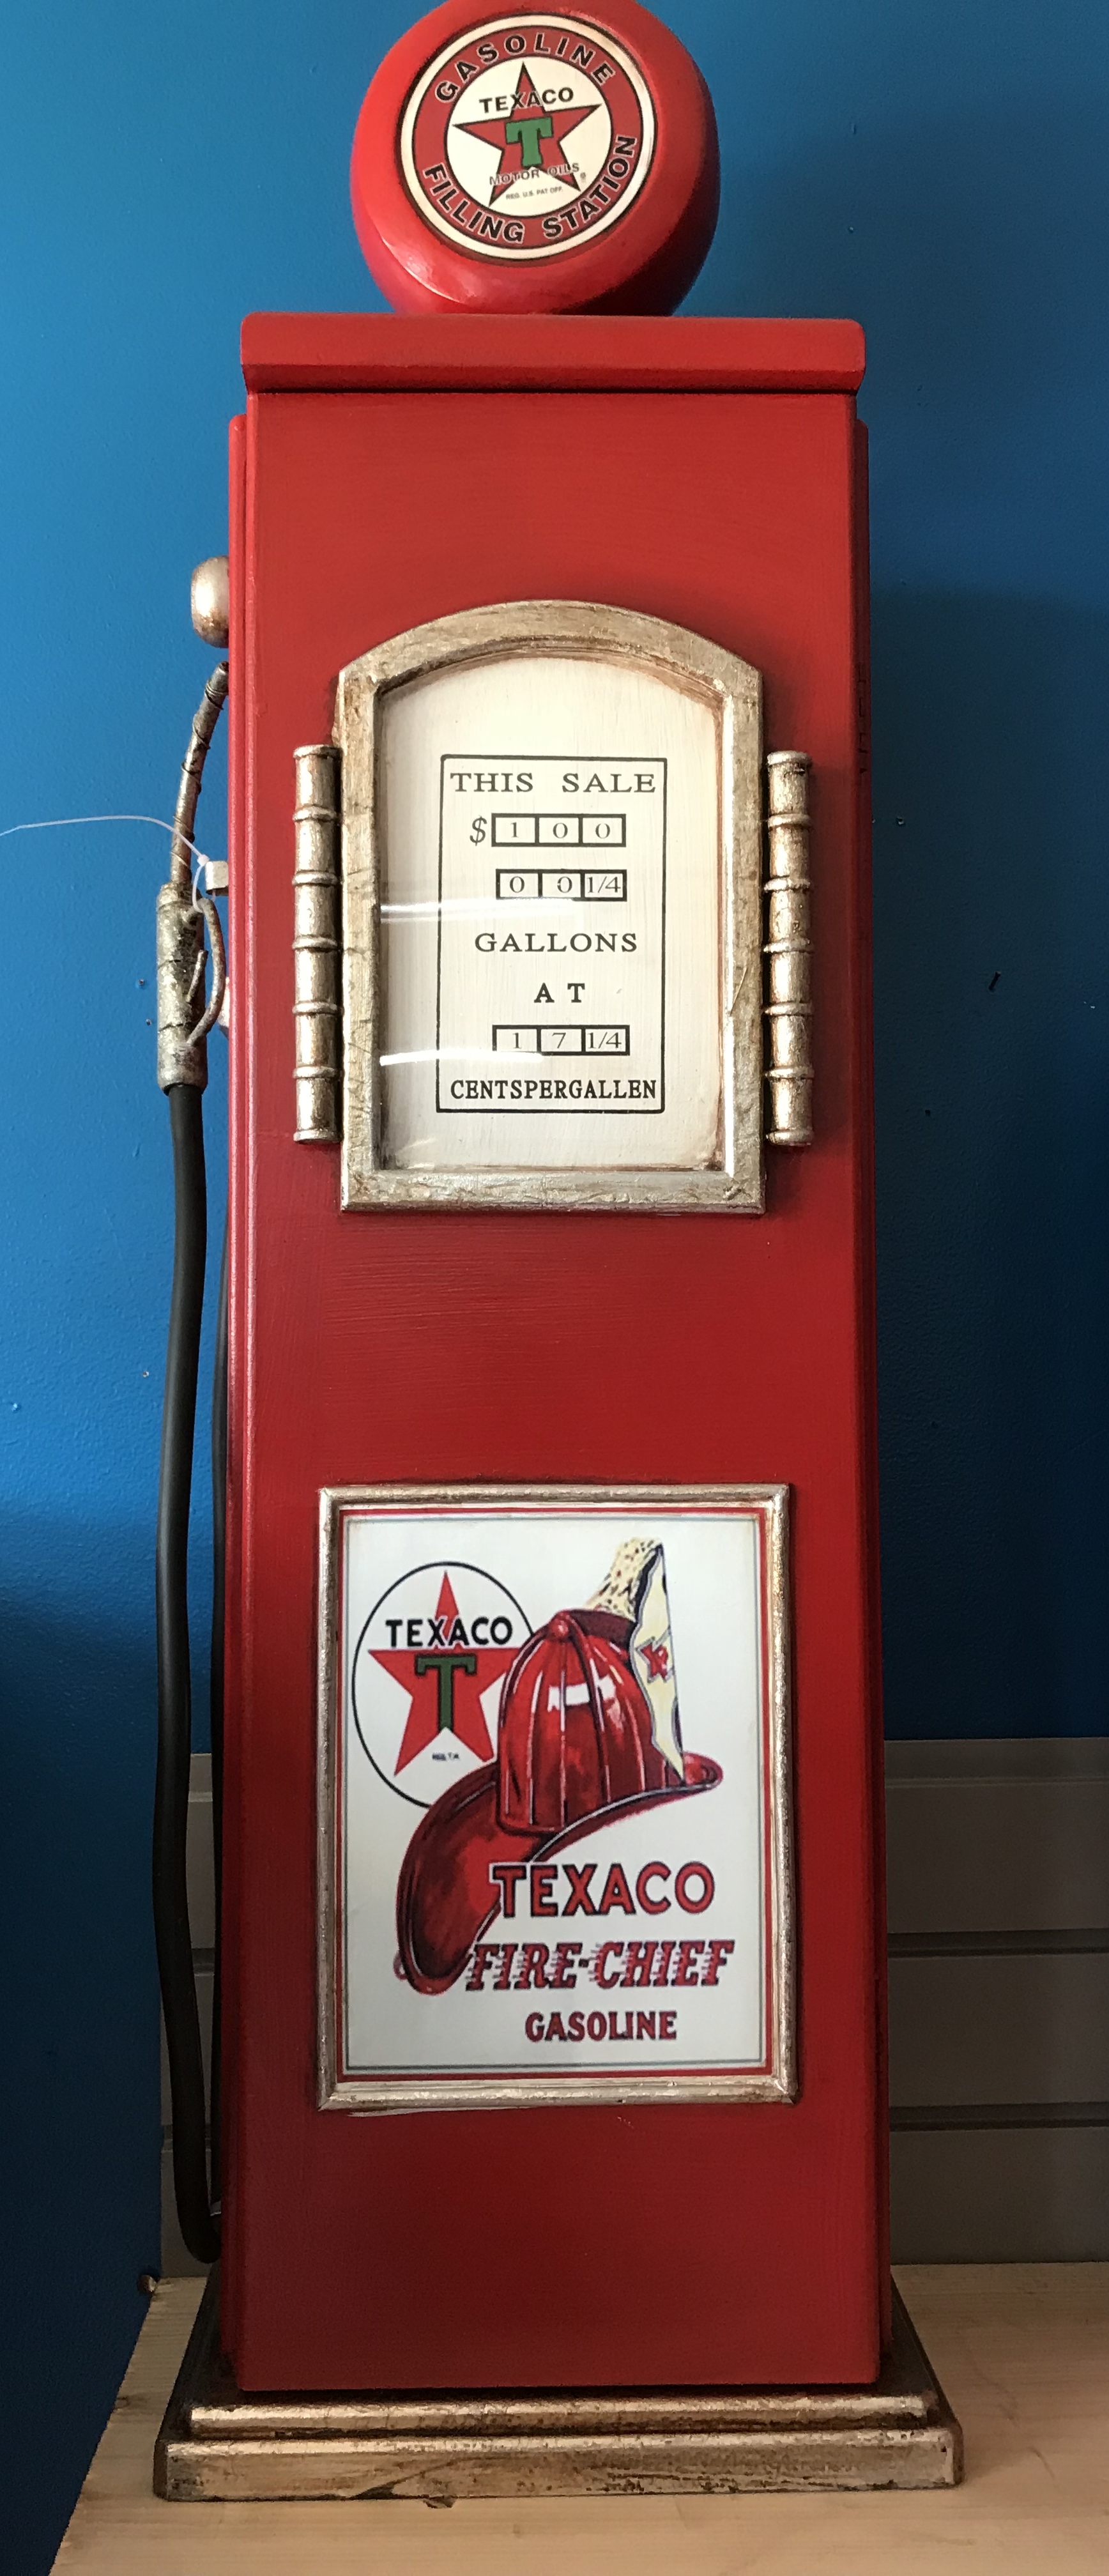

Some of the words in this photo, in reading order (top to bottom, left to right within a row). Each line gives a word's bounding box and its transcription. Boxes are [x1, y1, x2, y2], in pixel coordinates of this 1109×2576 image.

[436, 33, 615, 103] GASOLINE
[479, 87, 574, 114] TEXACO
[505, 116, 554, 169] T
[424, 162, 524, 243] FILLING
[542, 136, 637, 240] STATION
[489, 169, 540, 185] MOTOR
[547, 163, 579, 176] OILS
[450, 772, 533, 792] THIS
[562, 773, 656, 793] SALE
[475, 933, 637, 952] GALLONS
[450, 1080, 656, 1099] CENTSPERGALLEN
[386, 1616, 513, 1648] TEXACO
[415, 1653, 477, 1733] T
[493, 1861, 715, 1917] TEXACO
[465, 1939, 735, 1991] FIRE-CHIEF
[525, 2011, 677, 2042] GASOLINE
